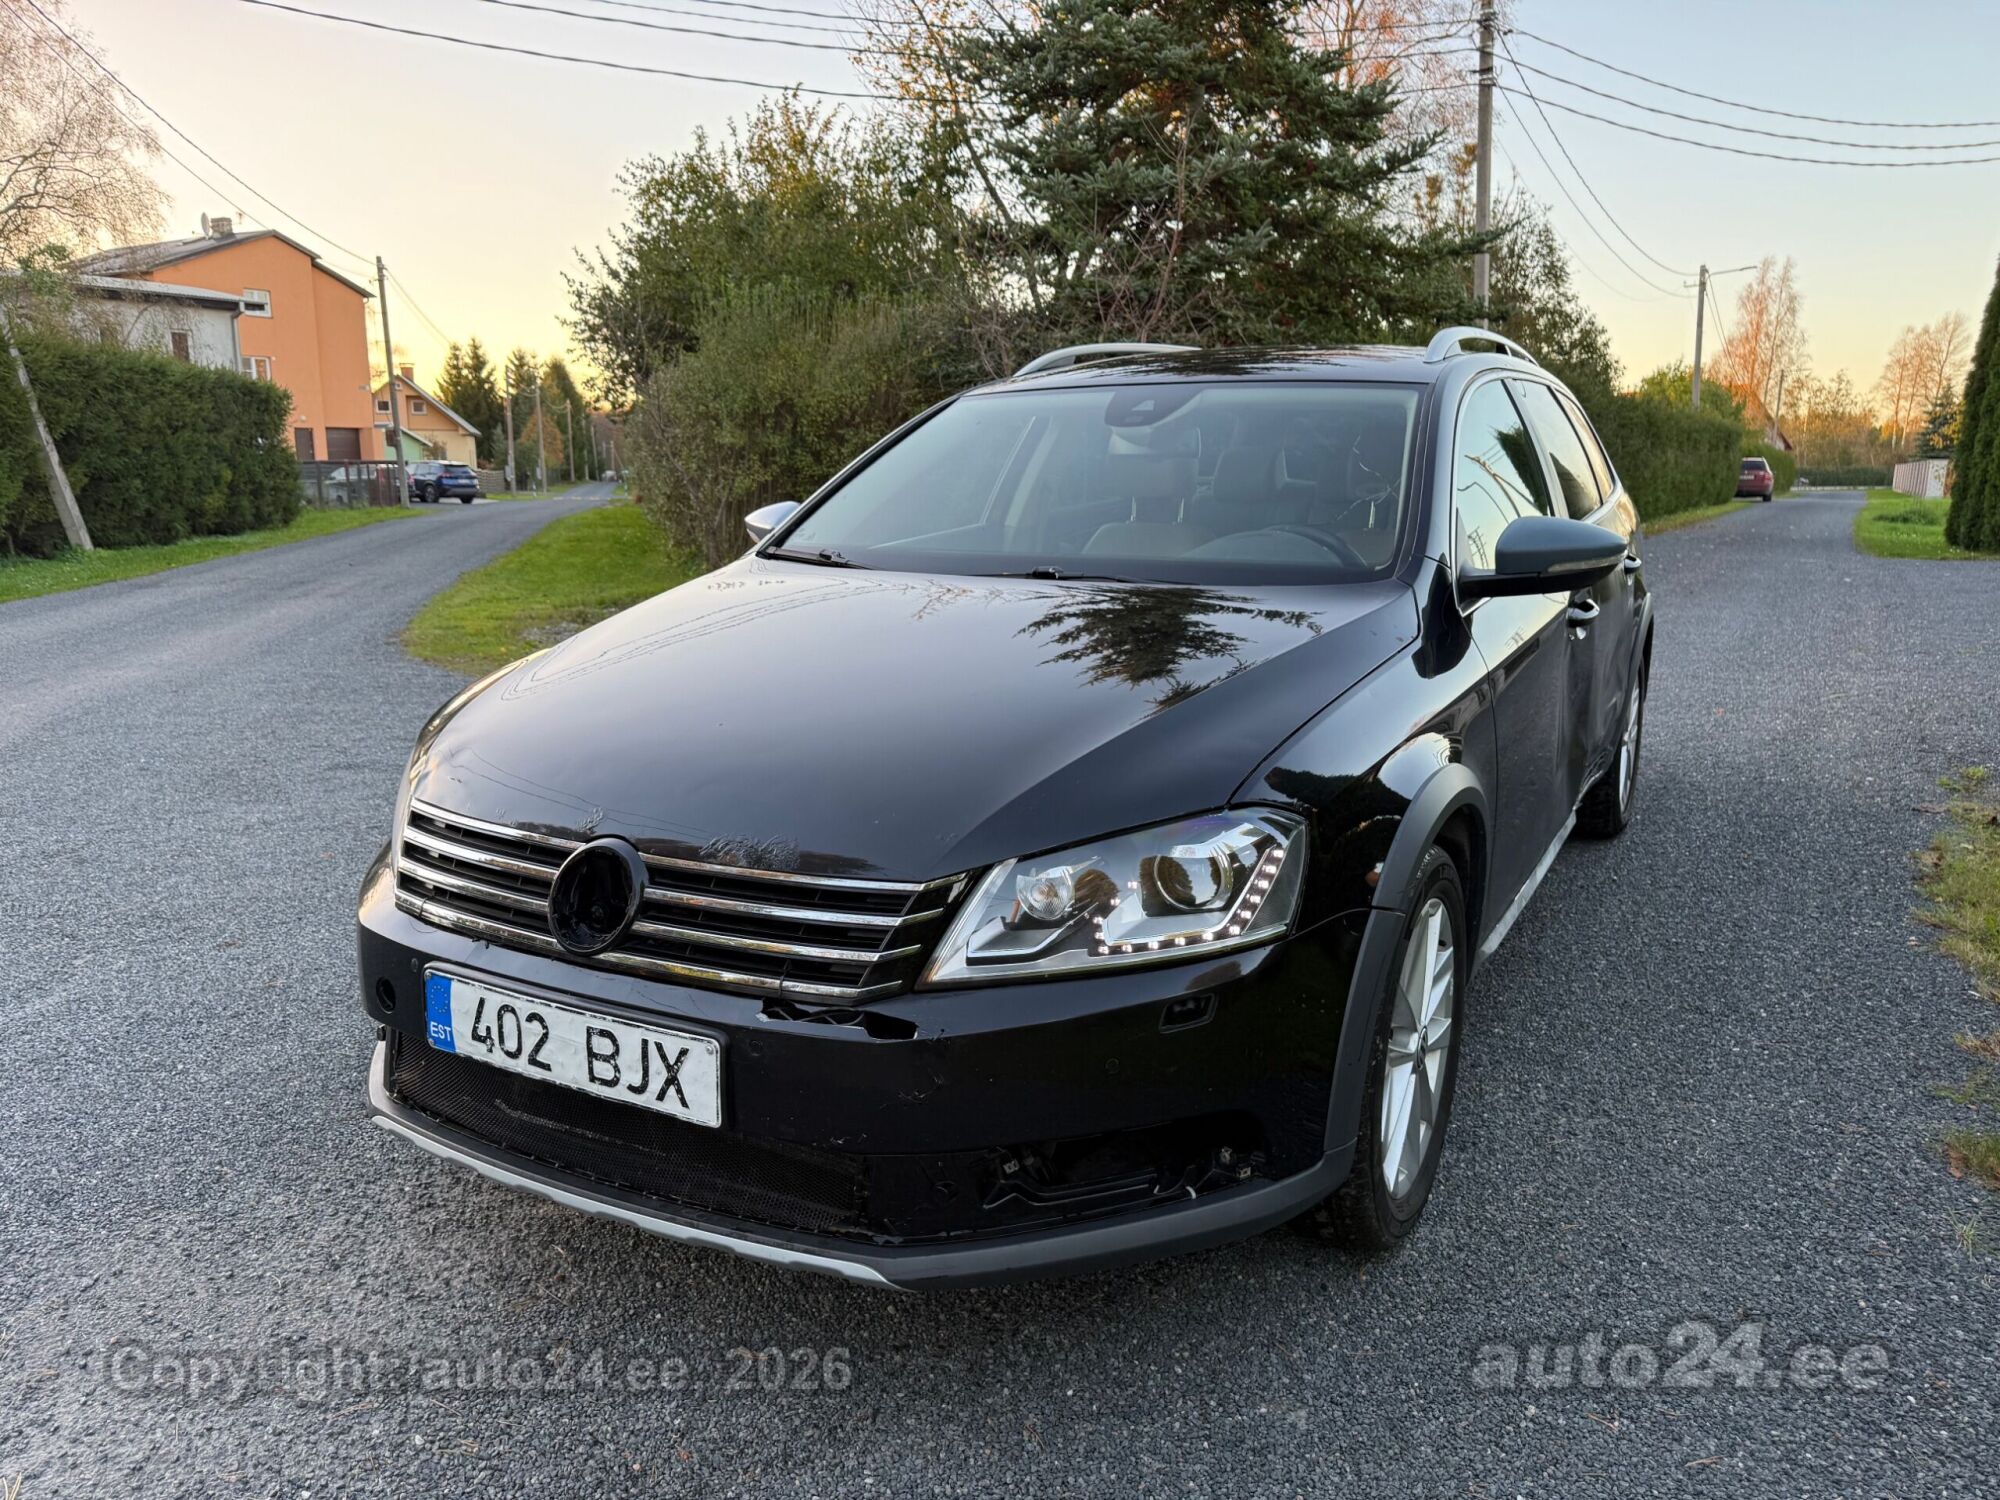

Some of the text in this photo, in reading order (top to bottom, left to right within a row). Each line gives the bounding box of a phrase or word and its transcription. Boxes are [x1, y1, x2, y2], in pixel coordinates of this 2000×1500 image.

[430, 1021, 451, 1041] EST
[471, 997, 690, 1109] 402 BJX
